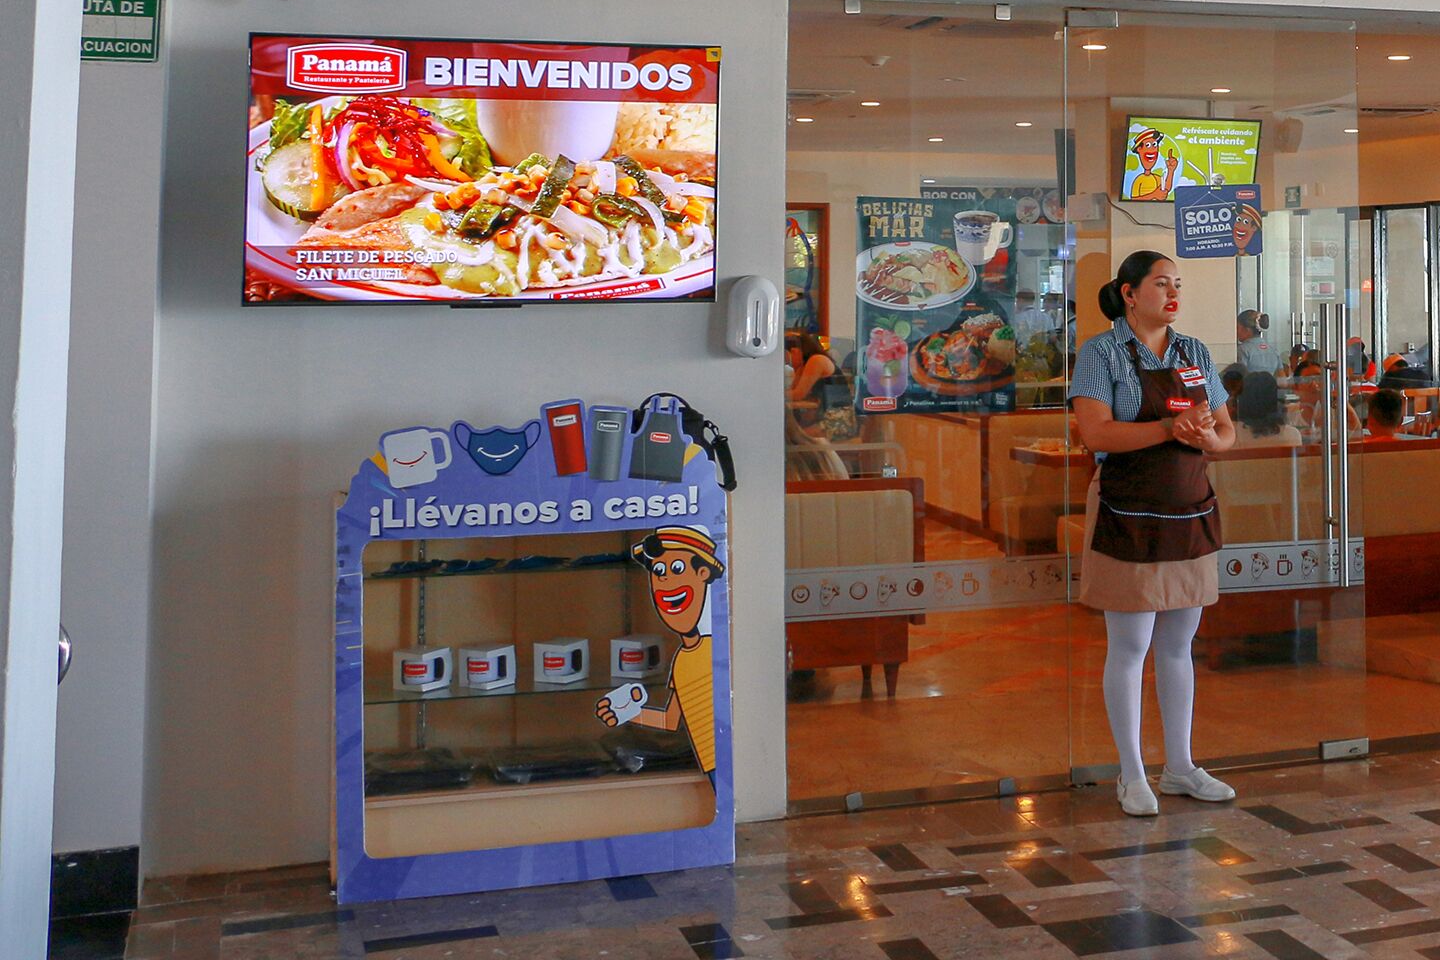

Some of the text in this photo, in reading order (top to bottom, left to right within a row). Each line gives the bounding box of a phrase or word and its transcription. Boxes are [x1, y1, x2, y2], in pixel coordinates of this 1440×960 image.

[120, 0, 145, 14] DE
[81, 40, 152, 54] CUACION
[301, 54, 393, 73] Panamá
[303, 75, 347, 83] Restaurante
[354, 76, 390, 84] Pastelería
[424, 56, 693, 92] BIENVENIDOS
[1219, 128, 1253, 136] cuidando
[1188, 136, 1246, 145] el ambiente
[862, 201, 934, 218] DELICIAS
[1185, 207, 1232, 226] SOLO
[869, 215, 925, 238] MAR
[1186, 223, 1232, 235] ENTRADA
[295, 250, 458, 264] FILETE DE PESCADO
[295, 267, 408, 281] SAN MIGUEL
[369, 485, 701, 537] ¡Llévanos a casa!
